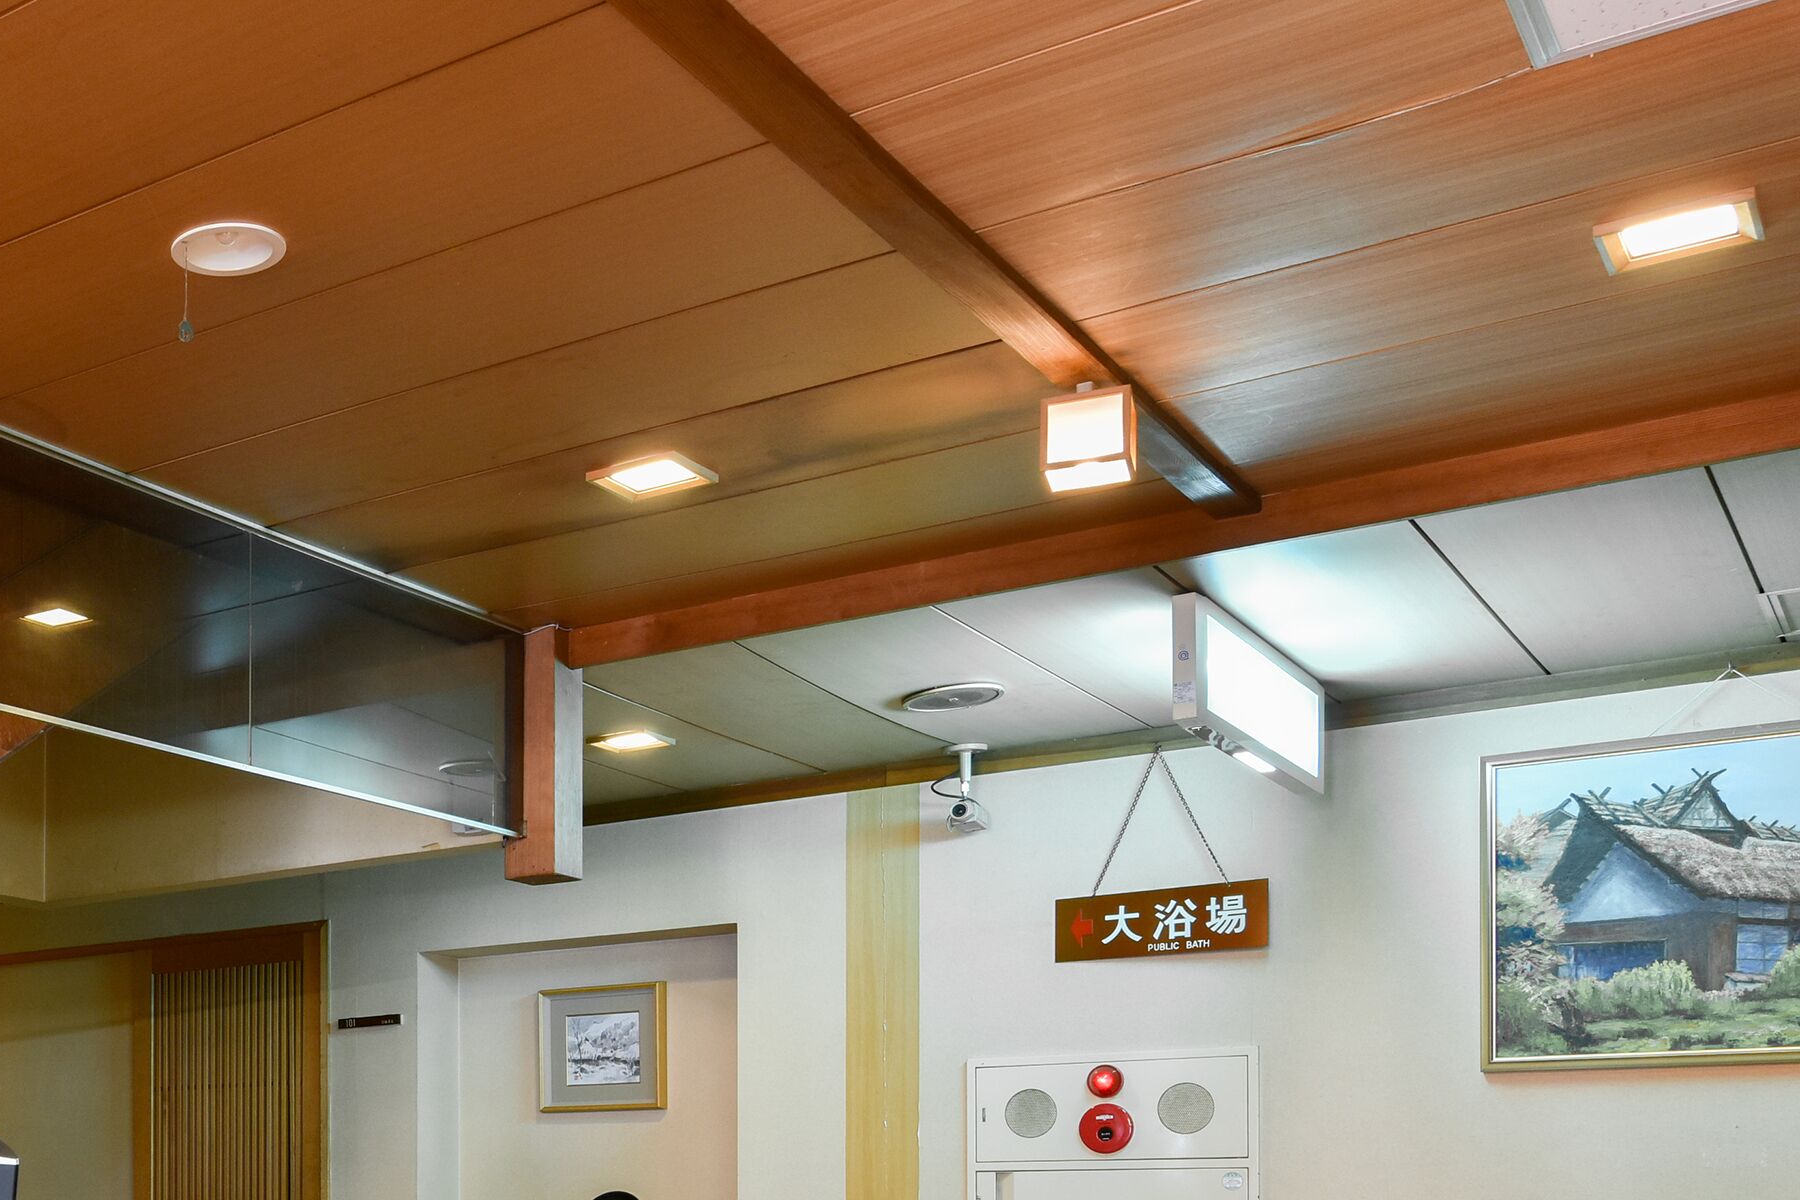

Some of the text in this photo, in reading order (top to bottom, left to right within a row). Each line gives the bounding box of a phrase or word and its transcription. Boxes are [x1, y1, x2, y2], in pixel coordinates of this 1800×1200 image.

[1101, 894, 1248, 945] 大浴場
[1148, 939, 1210, 952] PUBLIC BATH
